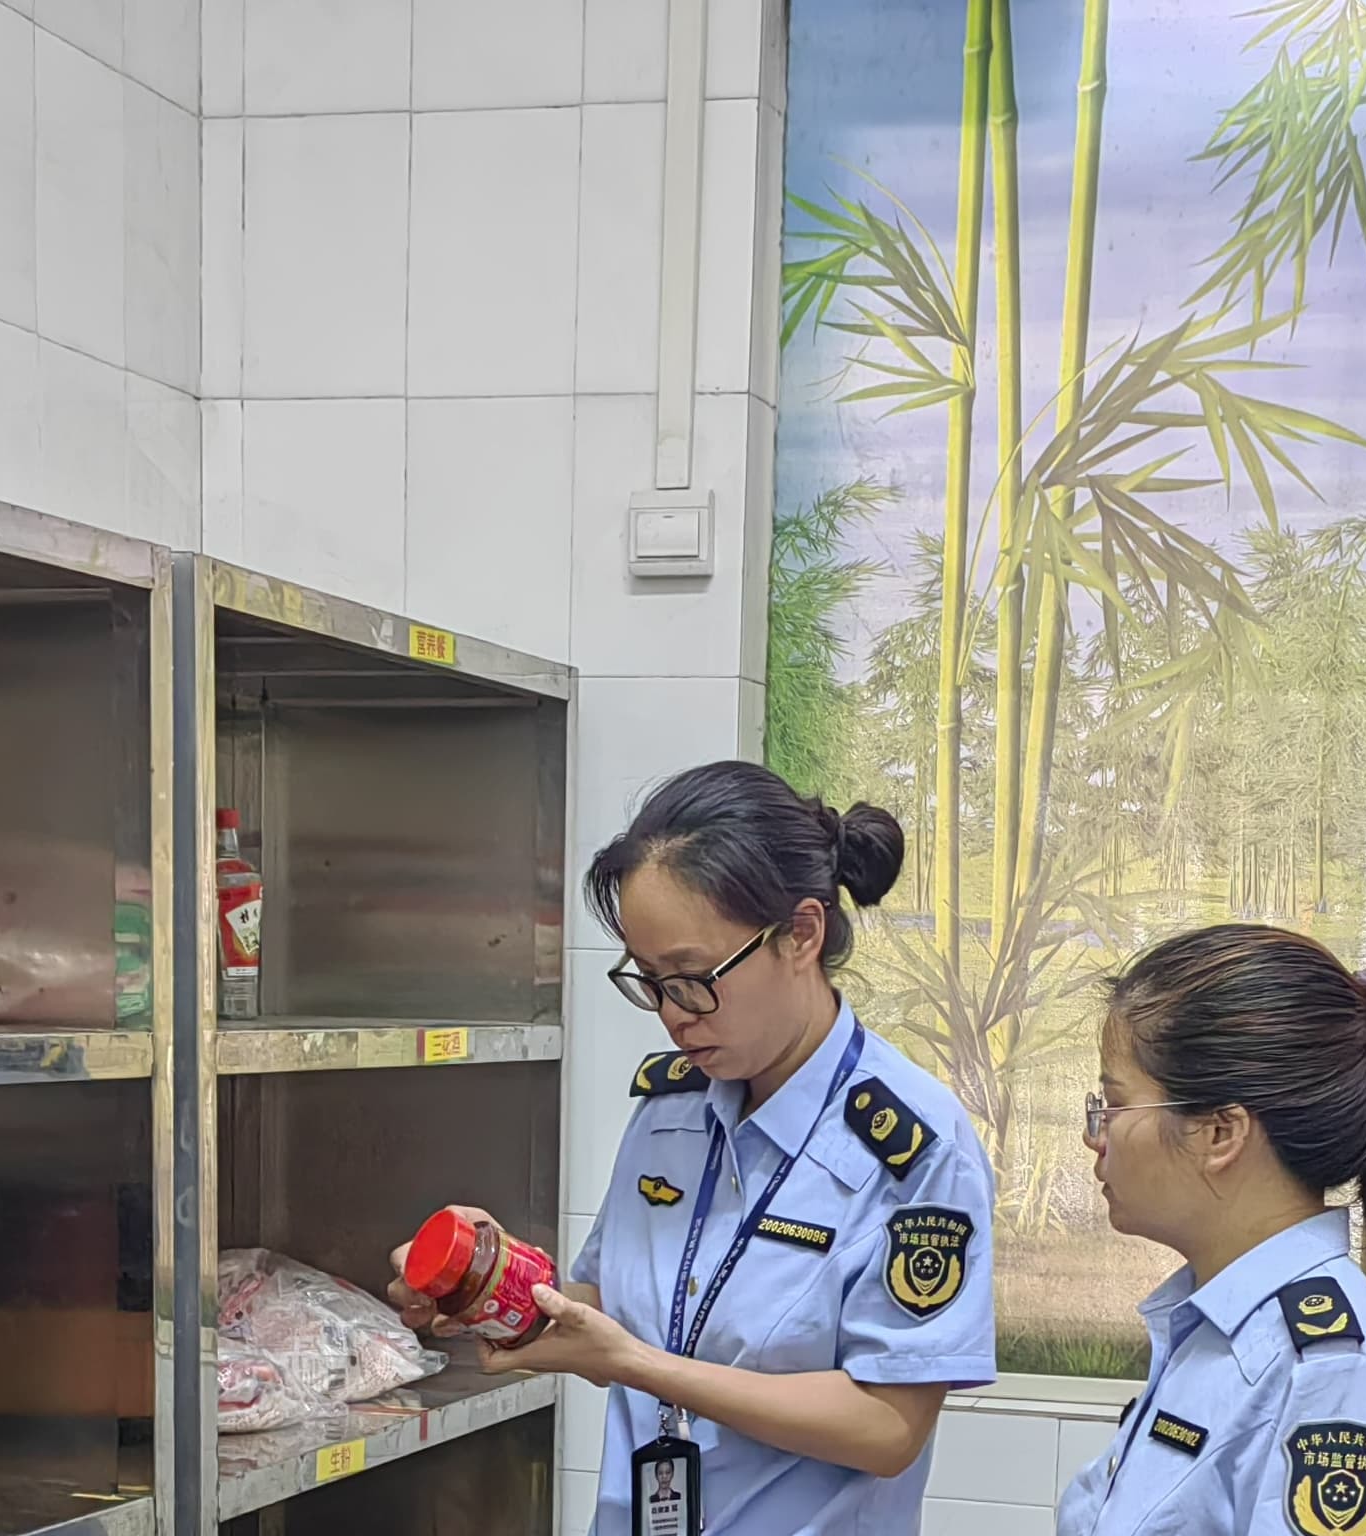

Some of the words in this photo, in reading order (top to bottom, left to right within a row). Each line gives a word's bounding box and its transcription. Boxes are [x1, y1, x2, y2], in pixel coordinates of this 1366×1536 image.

[757, 1217, 828, 1245] 20020630096
[893, 1215, 968, 1236] 中华人民共和国
[899, 1233, 960, 1248] 市场监管执法
